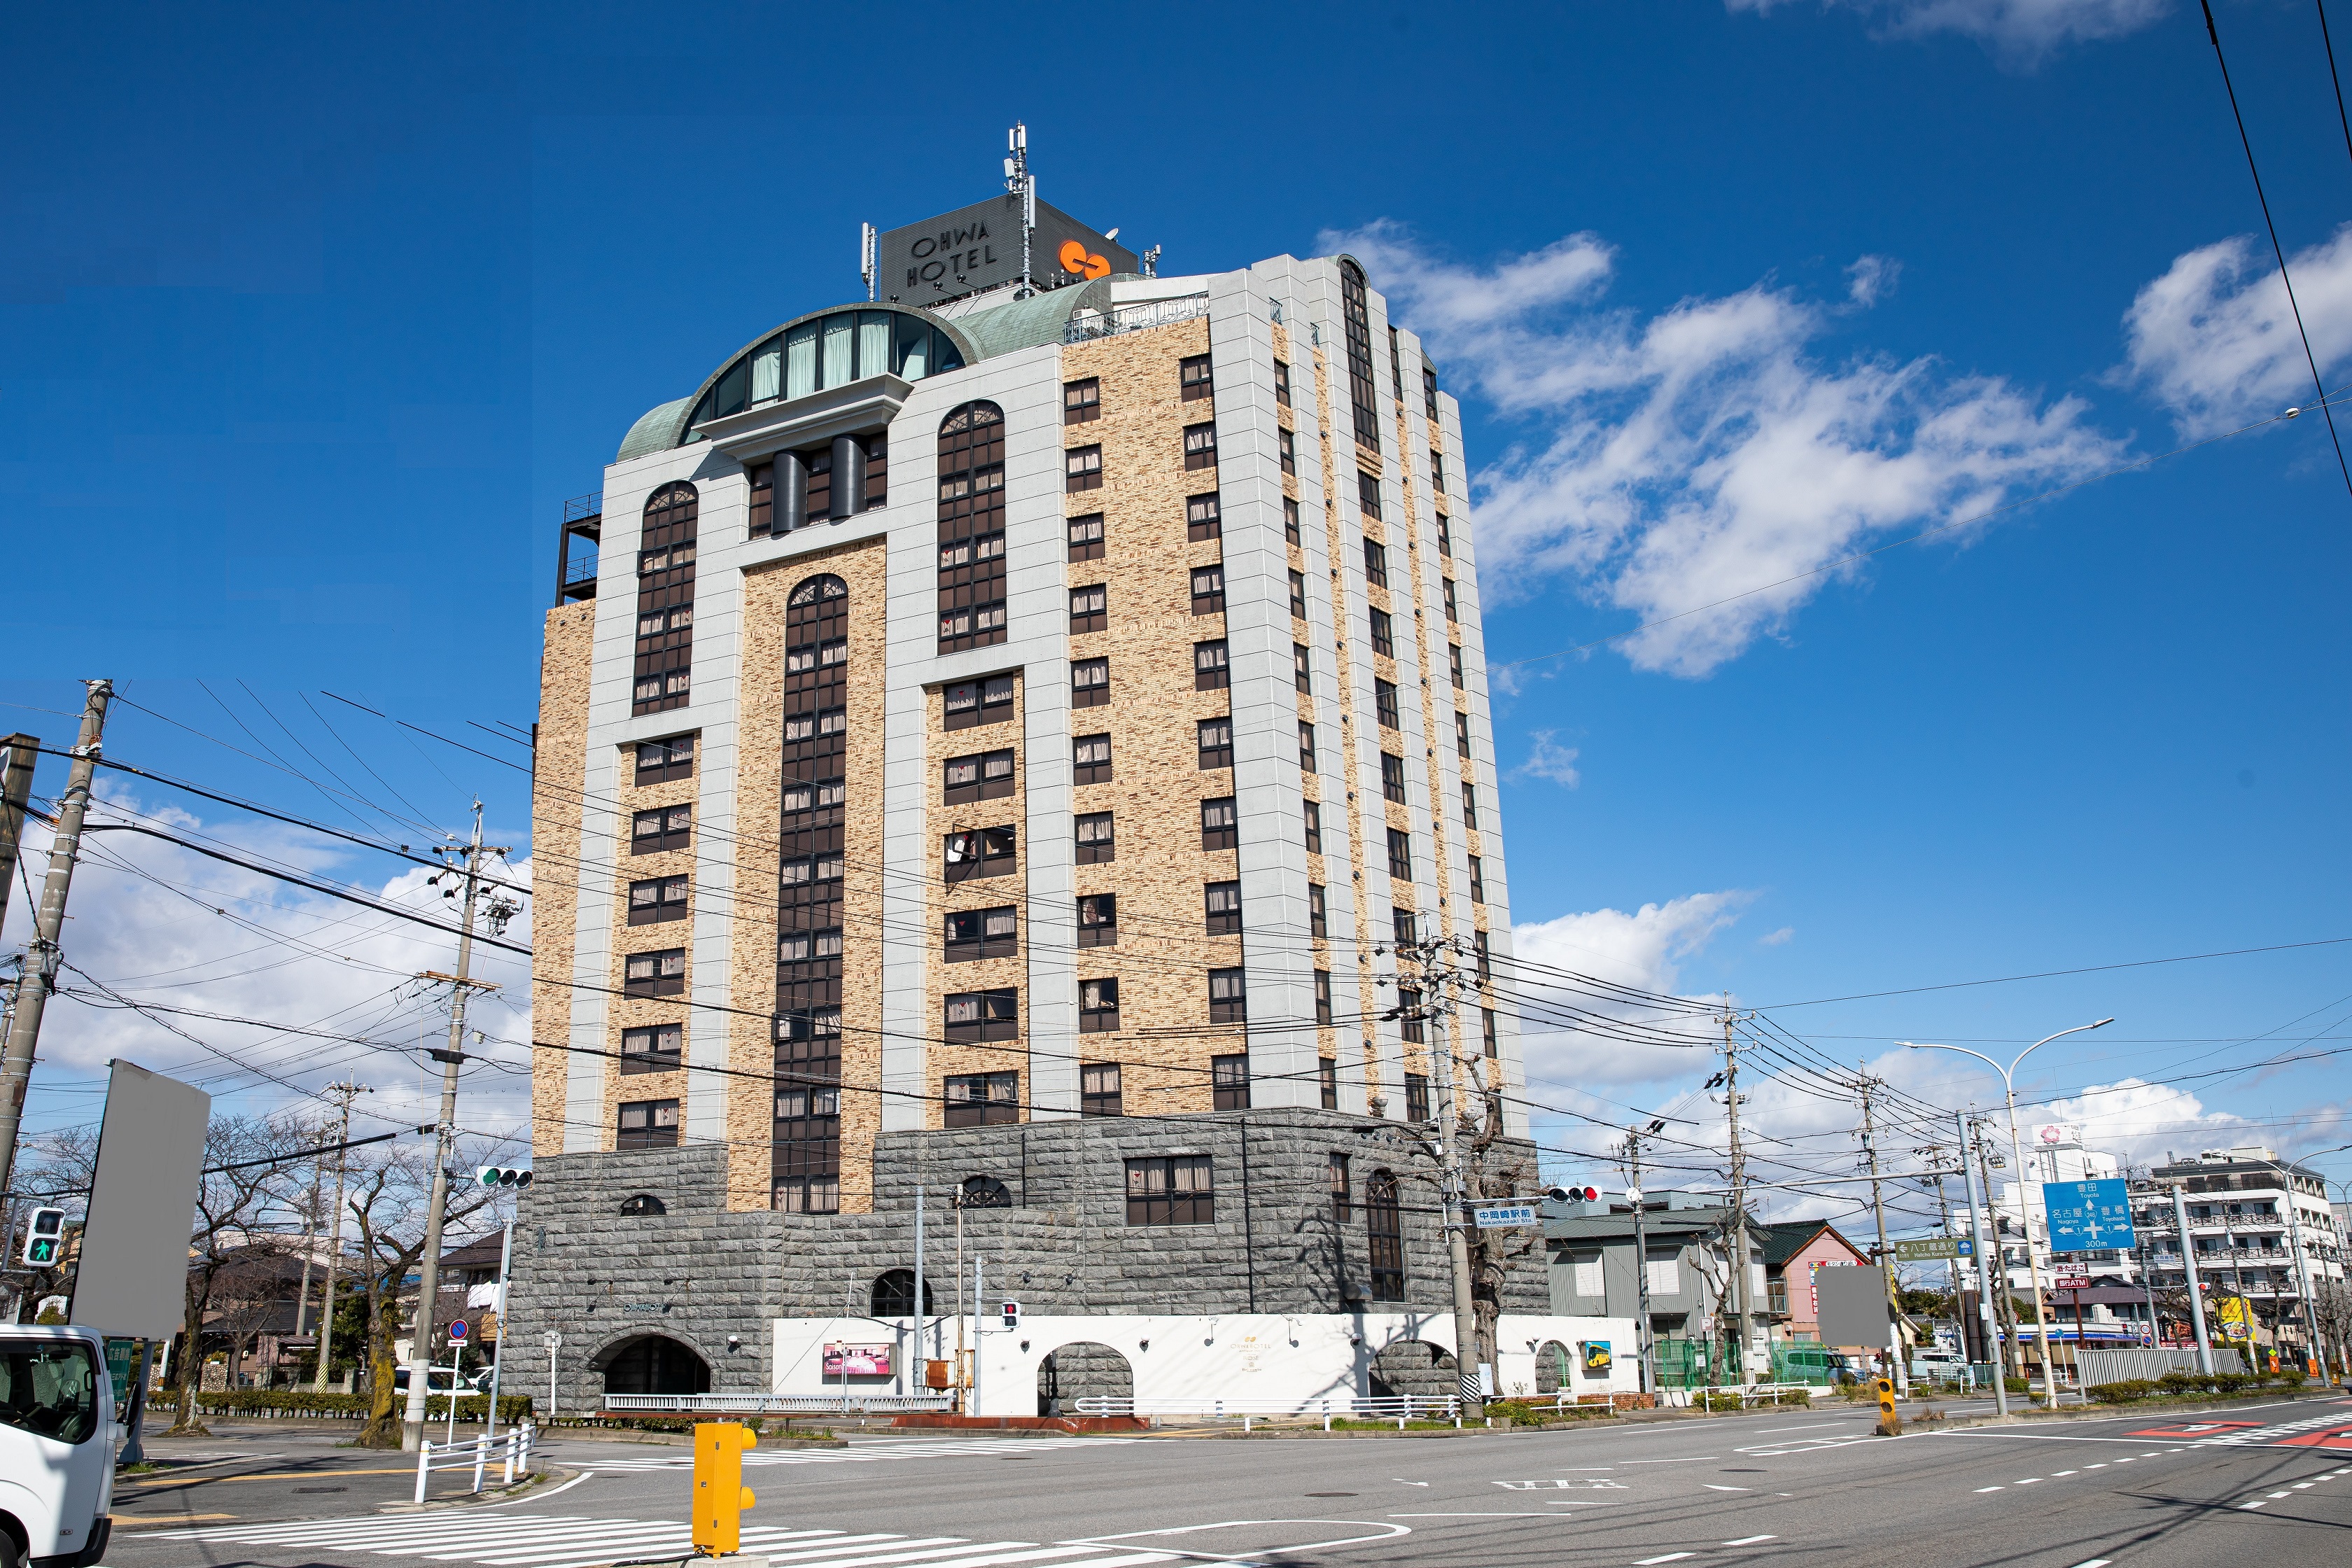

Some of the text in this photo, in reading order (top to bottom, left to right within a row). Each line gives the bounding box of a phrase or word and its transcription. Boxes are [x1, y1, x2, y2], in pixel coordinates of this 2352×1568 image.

[911, 220, 990, 258] OHWA
[907, 245, 997, 287] HOTEL
[2078, 1183, 2096, 1193] 豊田
[1479, 1209, 1530, 1219] 中岡崎駅前
[2052, 1208, 2082, 1219] 名古屋
[2101, 1205, 2124, 1216] 豊橋
[1910, 1241, 1955, 1252] 八丁蔵通り
[1702, 1319, 1711, 1329] P
